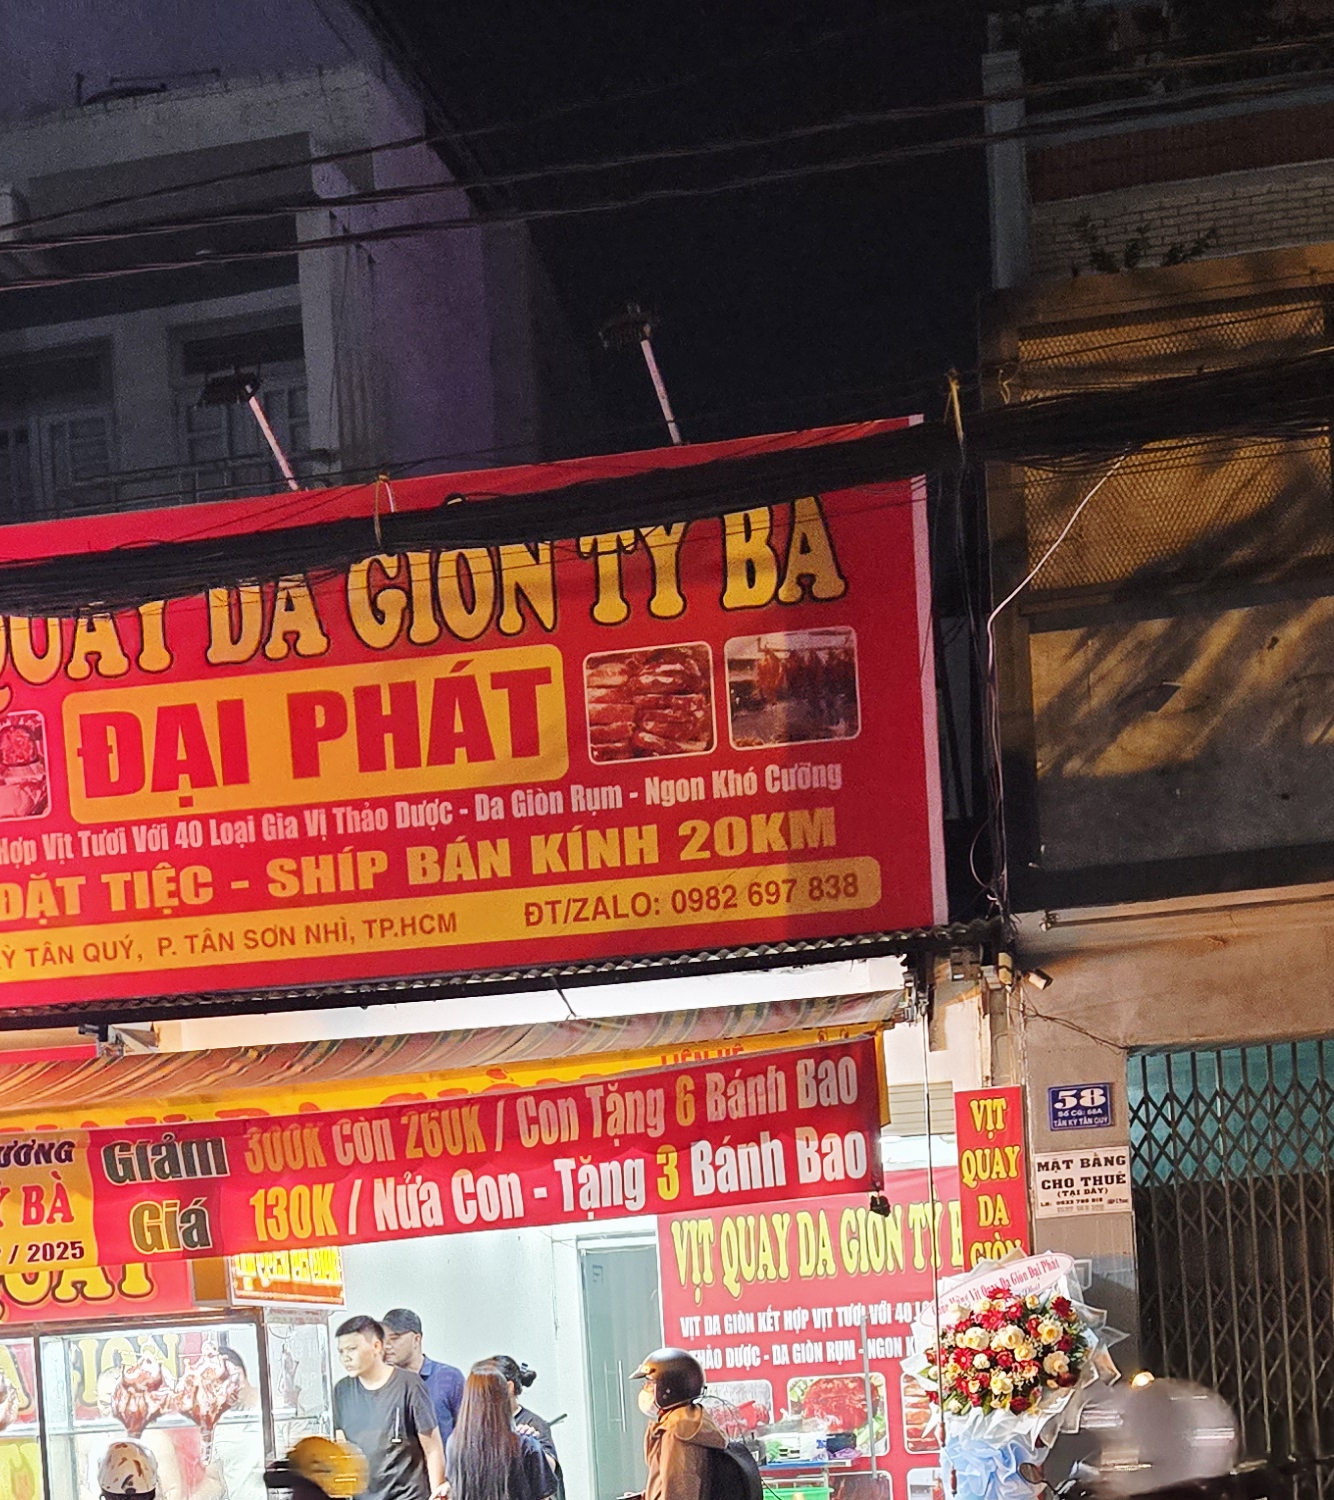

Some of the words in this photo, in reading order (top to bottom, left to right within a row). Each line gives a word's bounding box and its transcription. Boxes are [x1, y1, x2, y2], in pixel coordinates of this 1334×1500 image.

[76, 691, 250, 808] ĐẠI
[287, 659, 553, 779] PHÁT
[42, 832, 74, 866] Vịt
[78, 827, 128, 859] Tươi
[131, 822, 169, 852] Với
[175, 820, 203, 849] 40
[209, 816, 256, 848] Loại
[262, 812, 300, 842] Gia
[304, 809, 327, 840] Vị
[332, 801, 389, 835] Thảo
[395, 798, 453, 832] Dược
[475, 793, 505, 823] Da
[511, 787, 564, 819] Giòn
[570, 783, 623, 817] Rụm
[645, 773, 705, 807] Ngon
[712, 767, 758, 799] Khó
[101, 861, 213, 915] TIỆC
[266, 846, 388, 898] SHÍP
[406, 836, 512, 885] BÁN
[531, 824, 659, 875] KÍNH
[678, 807, 837, 861] 20KM
[524, 892, 661, 927] ĐT/ZALO:
[671, 884, 738, 914] 0982
[747, 878, 799, 907] 697
[808, 873, 859, 901] 838
[25, 940, 74, 967] TÂN
[157, 937, 177, 956] P.
[185, 928, 235, 954] TÂN
[244, 924, 296, 950] SƠN
[362, 912, 458, 939] TP.HCM
[244, 1120, 327, 1173] 300K
[400, 1103, 486, 1160] 260K
[516, 1093, 579, 1149] Con
[584, 1083, 665, 1147] Tặng
[675, 1074, 696, 1127] 6
[705, 1064, 787, 1122] Bánh
[797, 1055, 859, 1110] Bao
[969, 1098, 1007, 1140] VỊT
[1053, 1087, 1106, 1110] 58
[101, 1132, 230, 1187] Giảm
[249, 1182, 337, 1243] 130K
[373, 1172, 444, 1233] Nửa
[451, 1168, 525, 1225] Con
[554, 1154, 647, 1221] Tặng
[656, 1144, 681, 1200] 3
[691, 1130, 786, 1197] Bánh
[795, 1126, 868, 1184] Bao
[961, 1146, 1020, 1188] QUAY
[1041, 1177, 1074, 1190] CHO
[21, 1170, 75, 1226] BÀ
[977, 1193, 1009, 1227] DA
[27, 1240, 85, 1263] 2025
[129, 1196, 213, 1256] Giá
[970, 1231, 1021, 1270] GIÒ
[671, 1217, 715, 1305] VỊT
[720, 1211, 791, 1299] QUAY
[796, 1209, 836, 1277] DA
[680, 1315, 701, 1338] VỊT
[704, 1315, 721, 1335] DA
[724, 1309, 754, 1333] GIÒN
[758, 1304, 780, 1332] KẾT
[783, 1306, 809, 1334] HỢP
[812, 1307, 833, 1332] VỊT
[869, 1300, 892, 1326] VỚI
[895, 1303, 912, 1324] 40
[726, 1344, 761, 1371] DƯỢC
[772, 1344, 790, 1366] DA
[793, 1339, 823, 1364] GIÒN
[826, 1339, 856, 1366] RỤM
[868, 1337, 902, 1360] NGON
